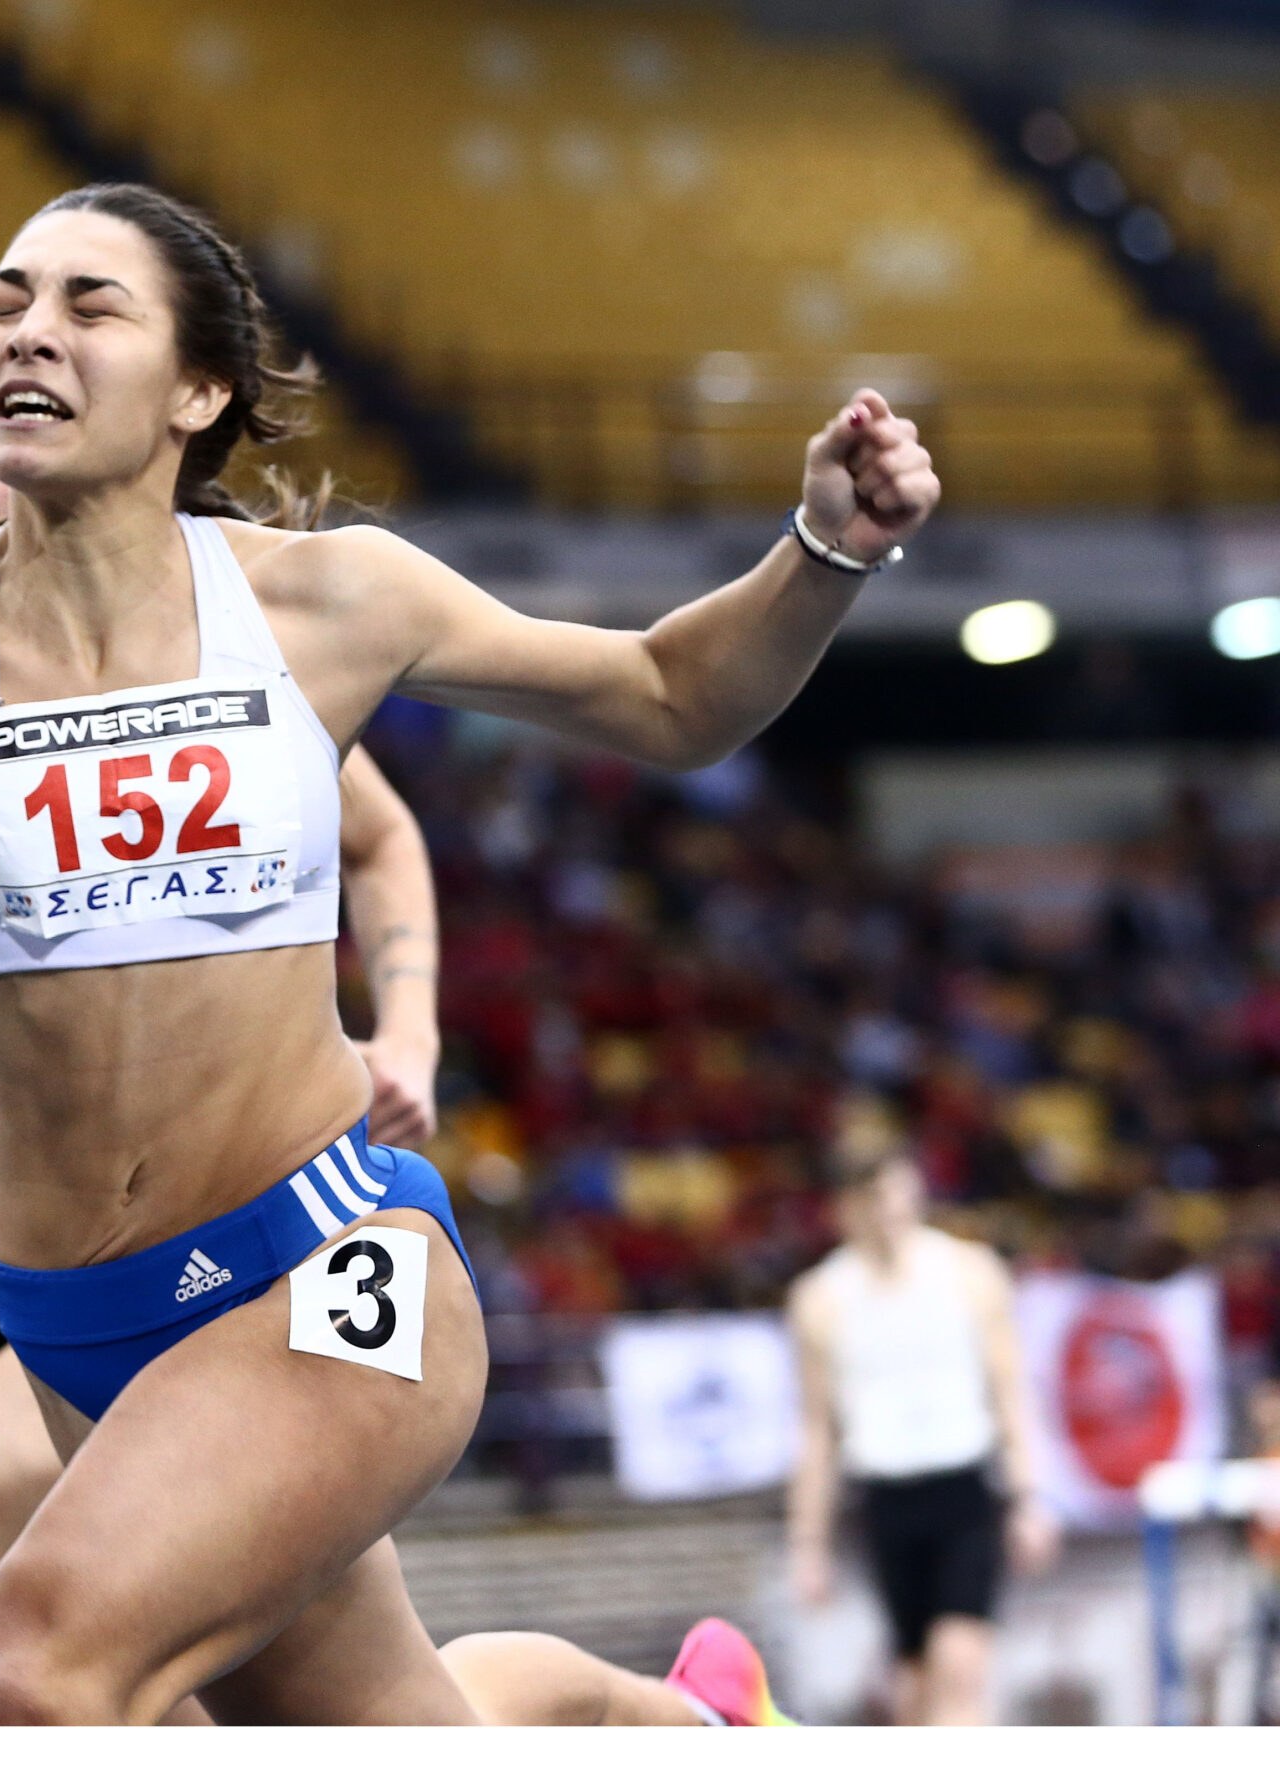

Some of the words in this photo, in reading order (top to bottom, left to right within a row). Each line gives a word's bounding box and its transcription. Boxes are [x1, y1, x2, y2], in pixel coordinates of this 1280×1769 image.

[24, 744, 241, 873] 152
[175, 1266, 233, 1302] adidas
[327, 1240, 397, 1350] 3
